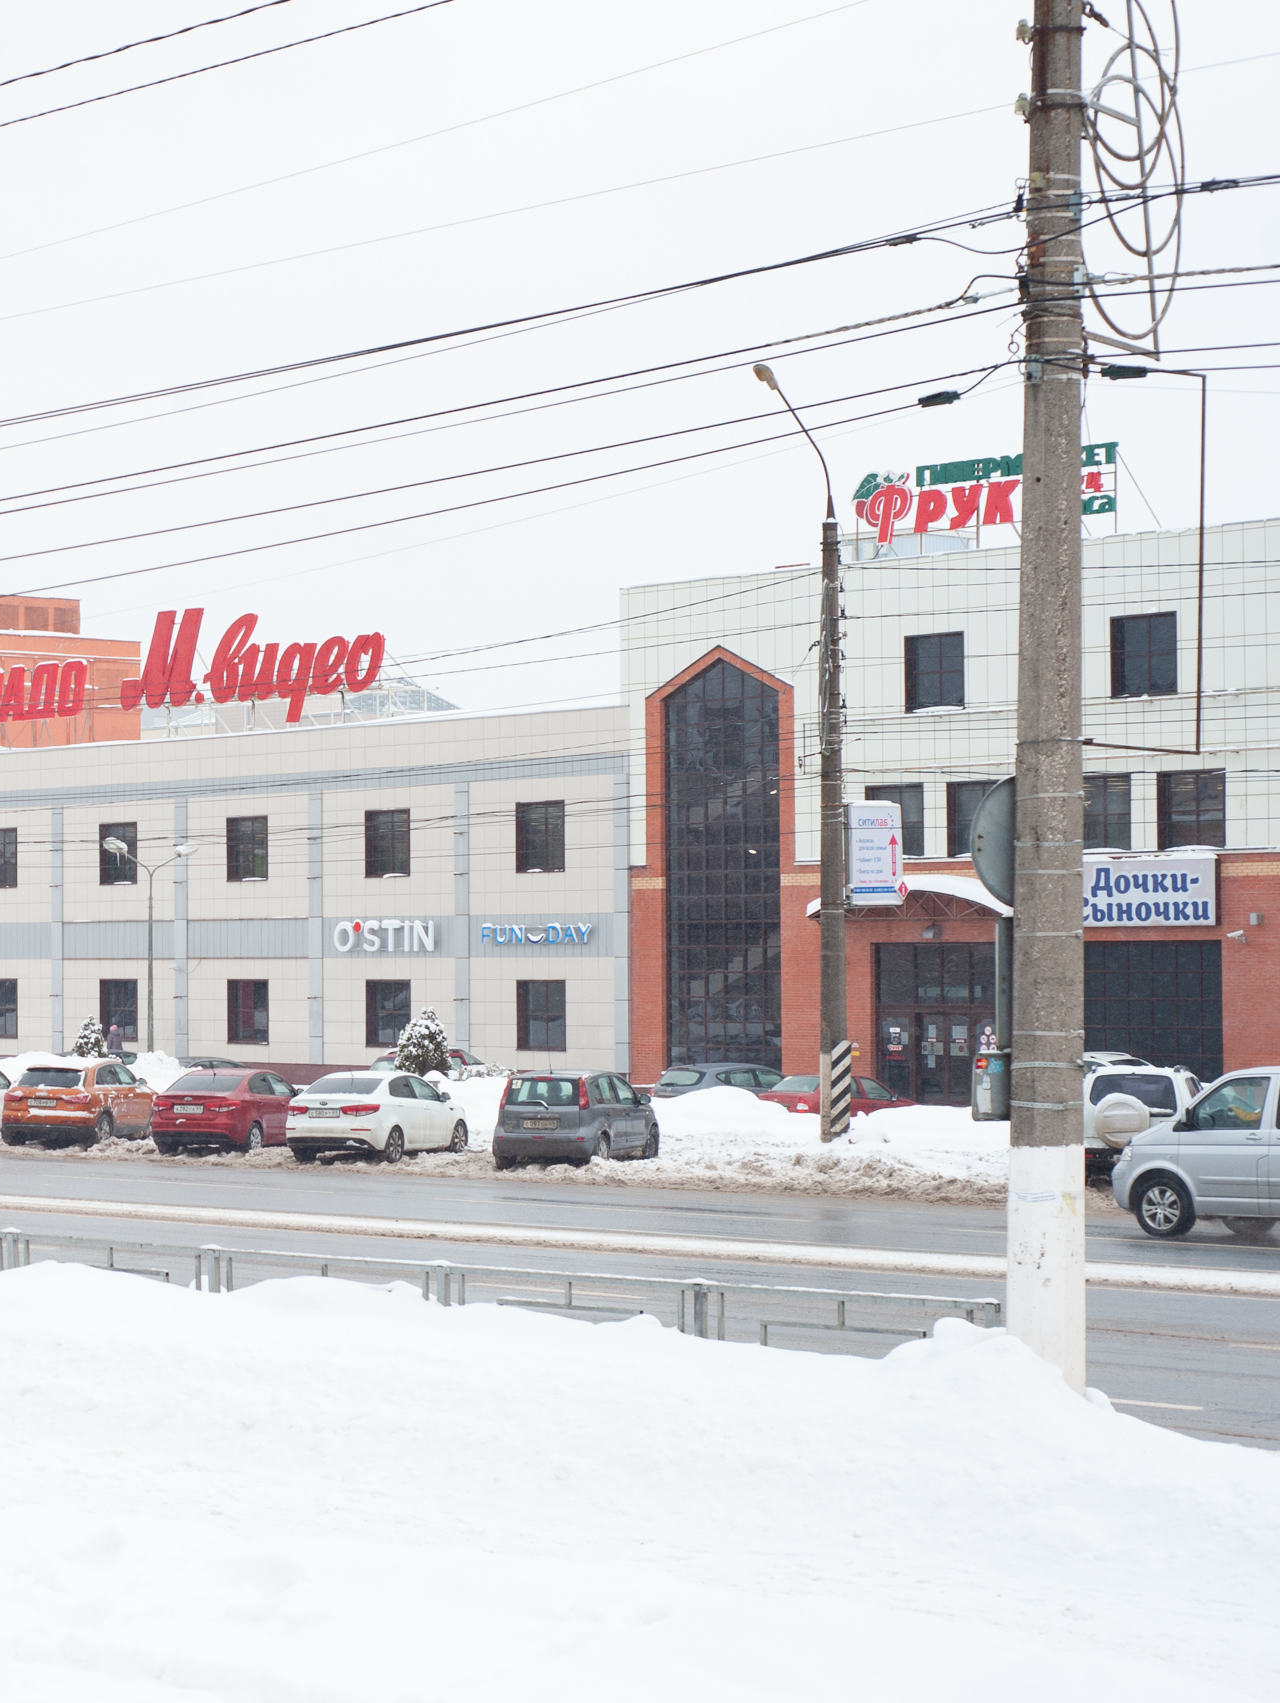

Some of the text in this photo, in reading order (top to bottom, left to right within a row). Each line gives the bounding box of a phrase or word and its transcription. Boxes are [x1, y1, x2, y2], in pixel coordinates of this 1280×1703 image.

[916, 441, 1119, 488] ГИПЕРМЕТ
[1081, 471, 1104, 494] 4
[1082, 494, 1116, 515] са
[1091, 867, 1199, 898] Дочки-
[481, 922, 592, 944] FUN DAY
